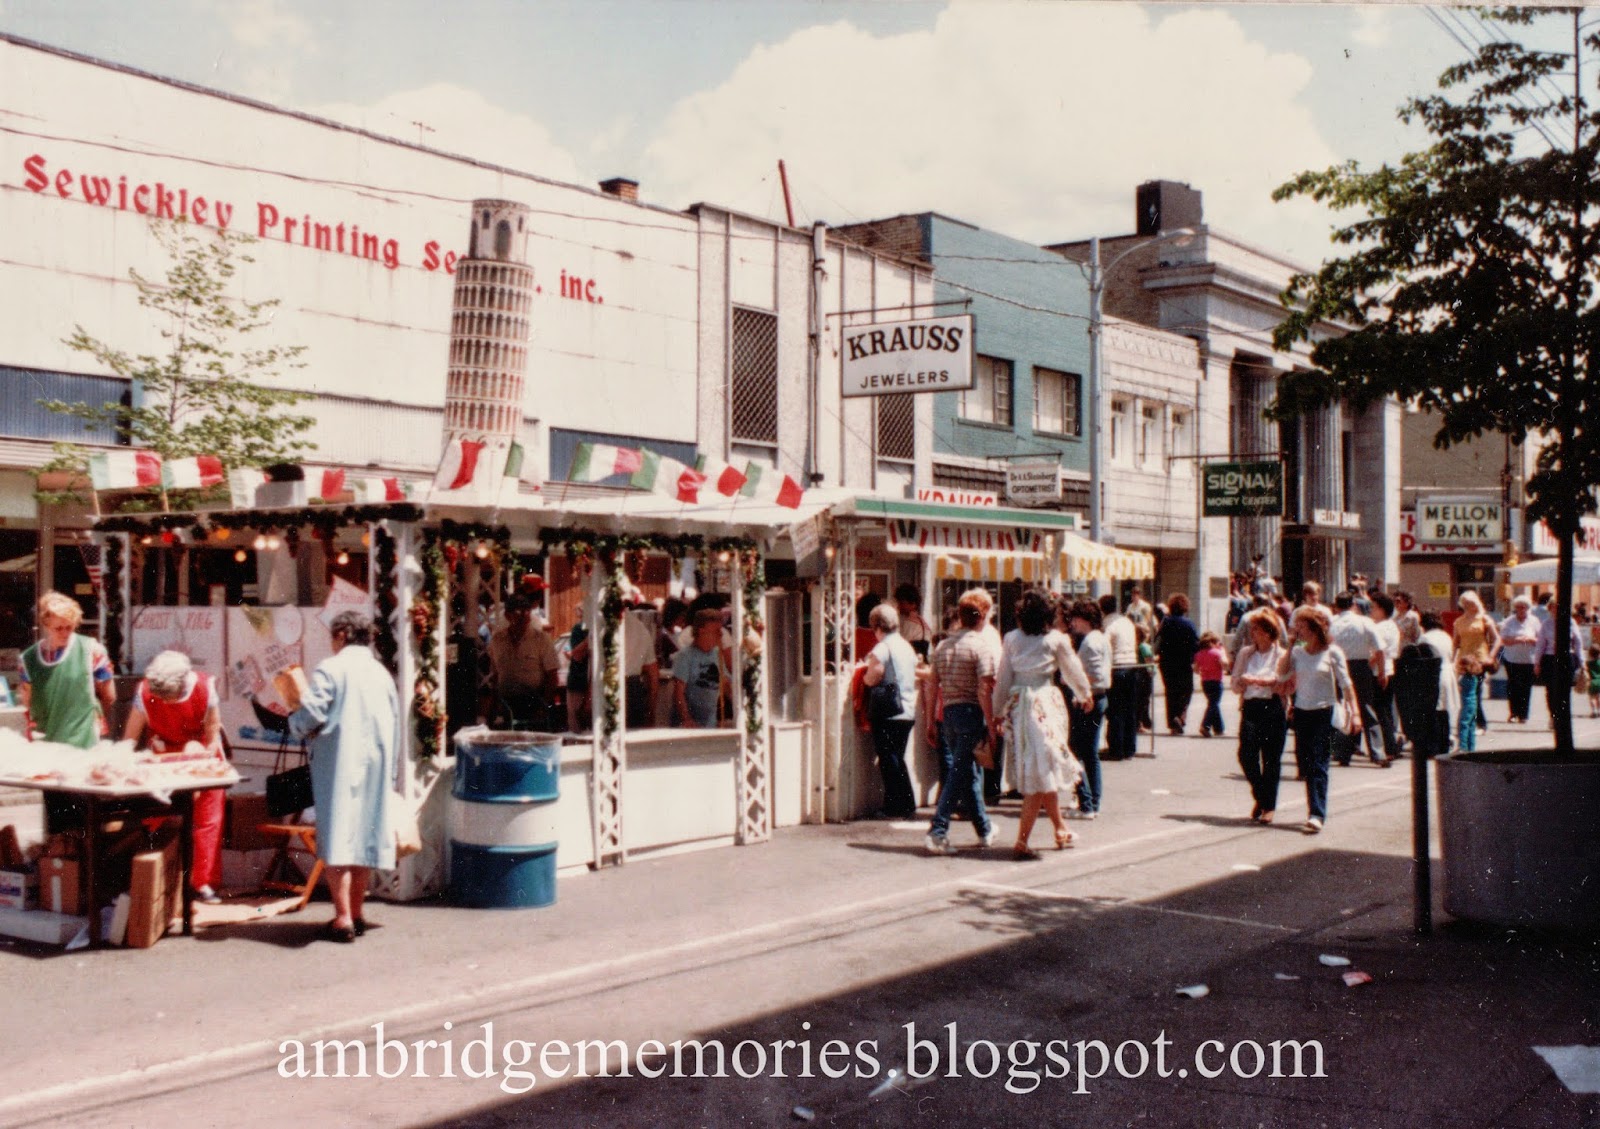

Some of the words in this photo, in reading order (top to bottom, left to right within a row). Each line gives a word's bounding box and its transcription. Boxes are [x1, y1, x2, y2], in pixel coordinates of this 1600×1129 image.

[23, 154, 233, 231] Sewickley
[257, 202, 400, 269] Printing
[846, 325, 963, 361] KRAUSS
[860, 370, 949, 389] JEWELERS
[1011, 484, 1056, 494] OPTOMETRIST
[1207, 496, 1240, 507] MONEY
[1425, 506, 1498, 520] MELLON
[932, 526, 1005, 550] ITALIAN
[1436, 524, 1488, 538] BANK
